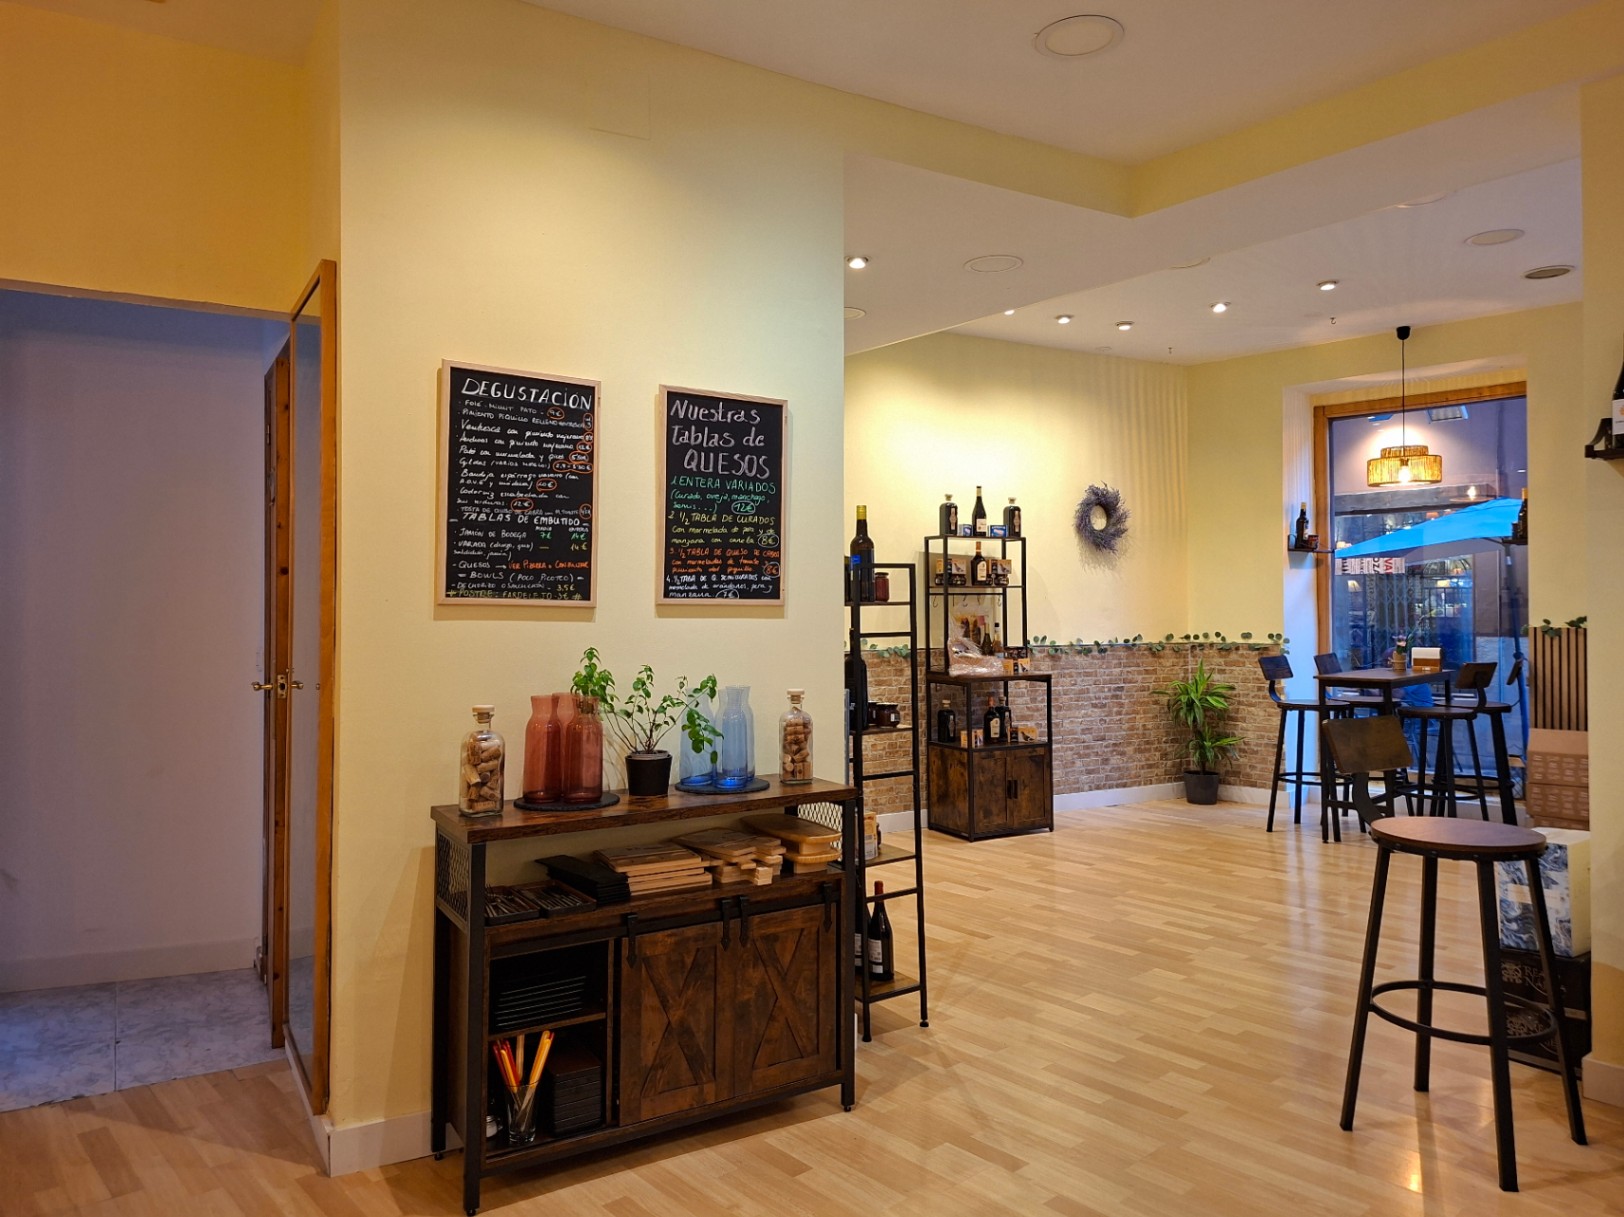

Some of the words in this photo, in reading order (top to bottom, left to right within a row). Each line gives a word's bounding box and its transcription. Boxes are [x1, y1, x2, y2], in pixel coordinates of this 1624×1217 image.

[670, 400, 760, 424] Nuestras
[742, 426, 765, 446] de
[683, 448, 770, 479] QUESOS
[726, 479, 776, 494] VARIADOS
[462, 512, 511, 522] TABLAS
[517, 515, 528, 524] DE
[534, 516, 580, 526] EMBUTIDO
[470, 571, 504, 579] BOWLS
